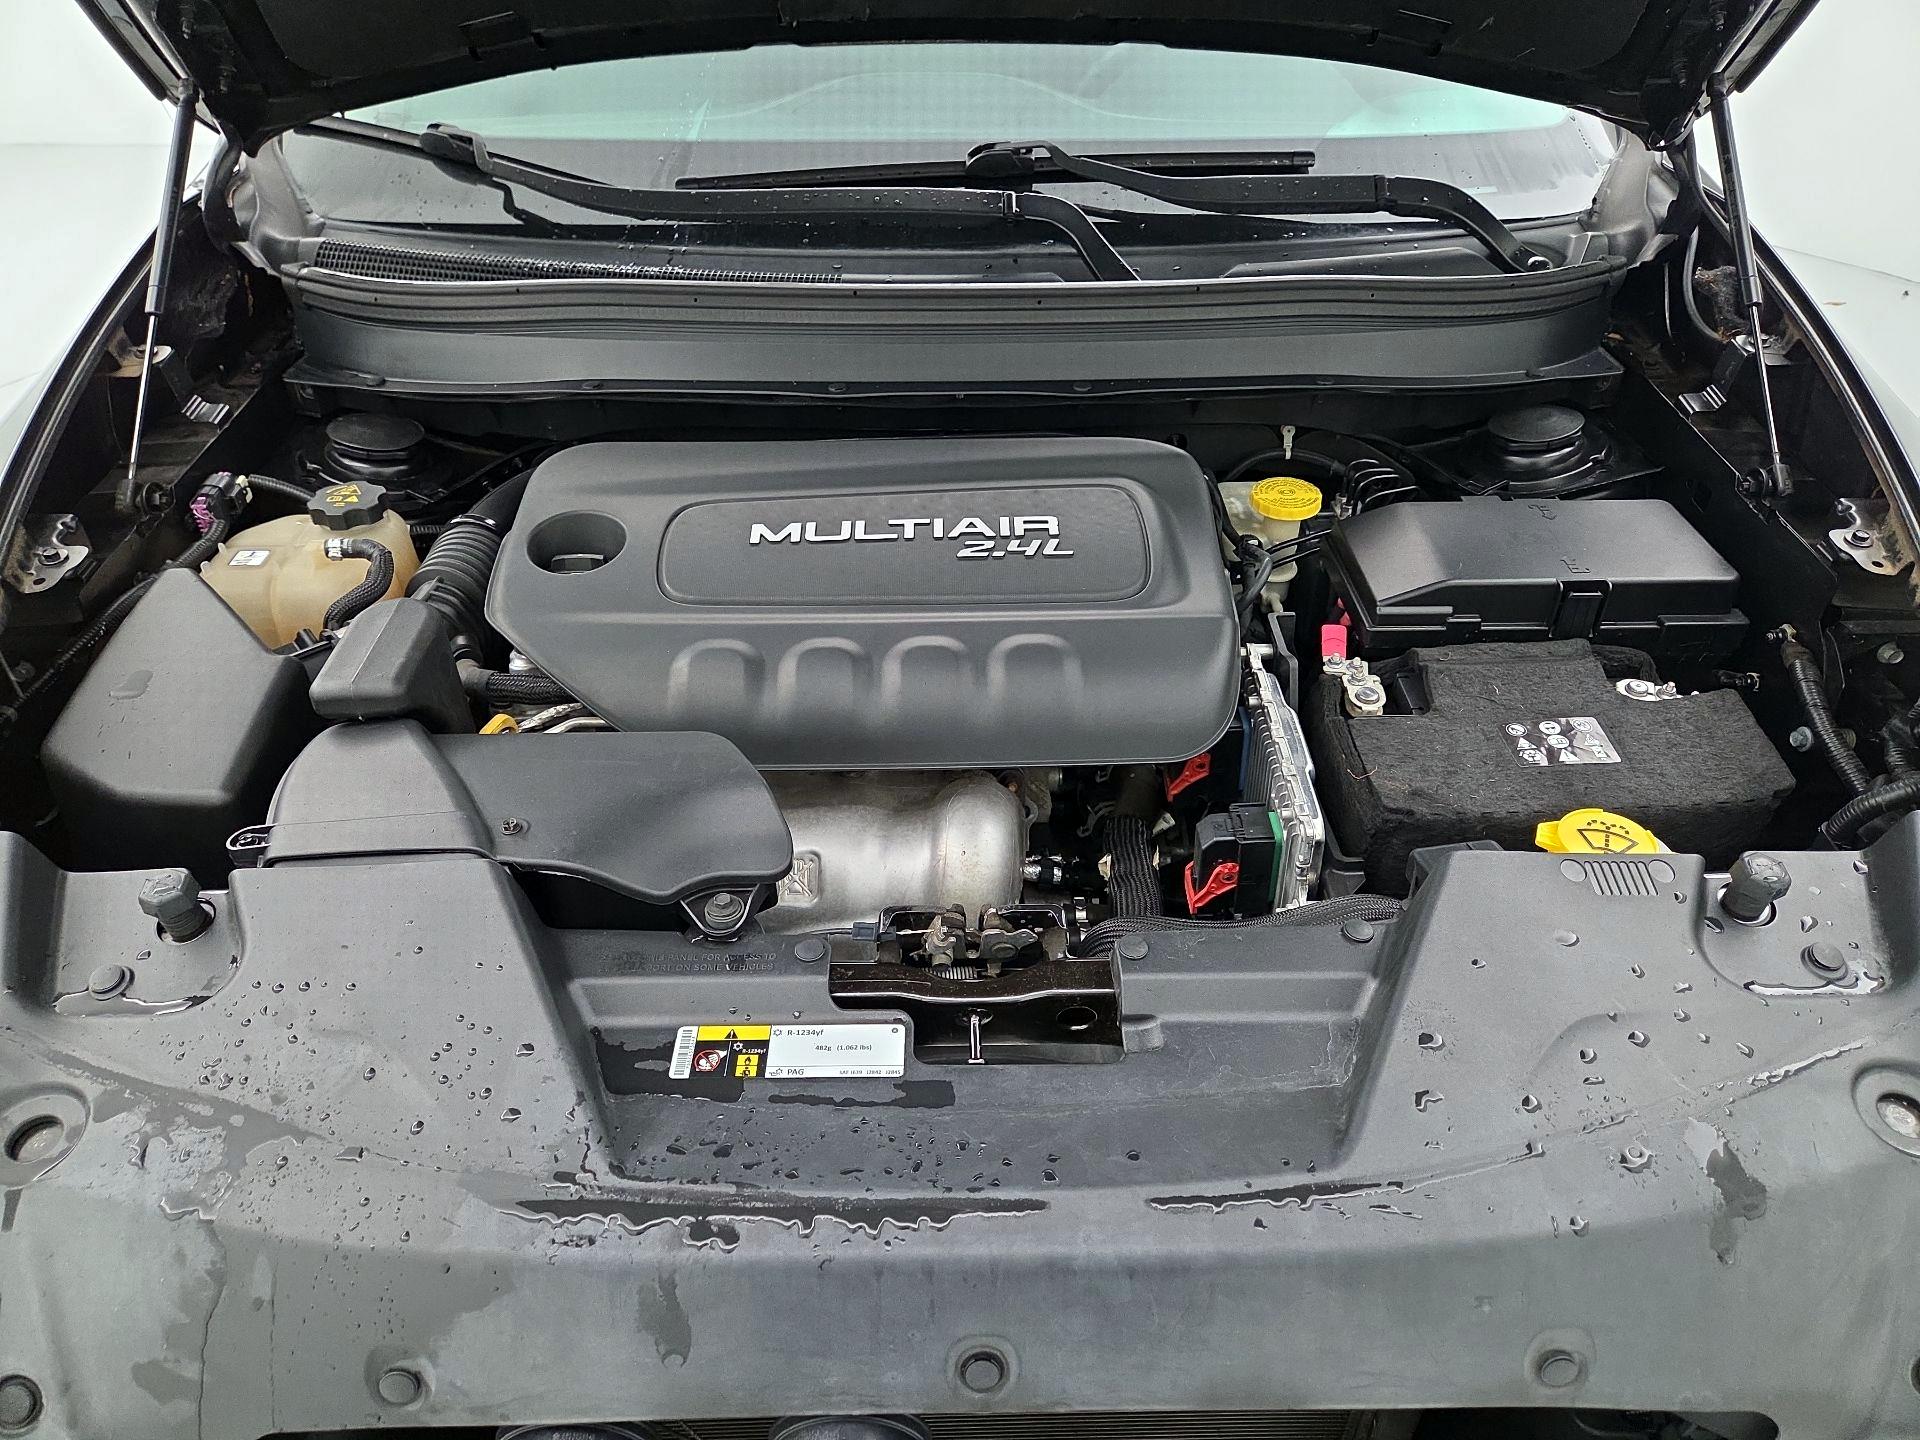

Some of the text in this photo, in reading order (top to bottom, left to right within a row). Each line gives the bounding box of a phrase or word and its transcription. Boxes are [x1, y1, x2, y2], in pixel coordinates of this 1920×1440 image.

[749, 515, 1061, 544] MULTIAIR
[956, 538, 1075, 557] 2.4L
[702, 953, 721, 961] FOR
[763, 952, 777, 960] TO
[675, 963, 692, 971] ON
[693, 963, 723, 971] SOME
[725, 962, 776, 971] VEHICLES
[787, 1029, 824, 1037] R-1234yf
[837, 1044, 858, 1052] (1.062
[859, 1044, 872, 1052] lbs)
[787, 1068, 805, 1076] PAG
